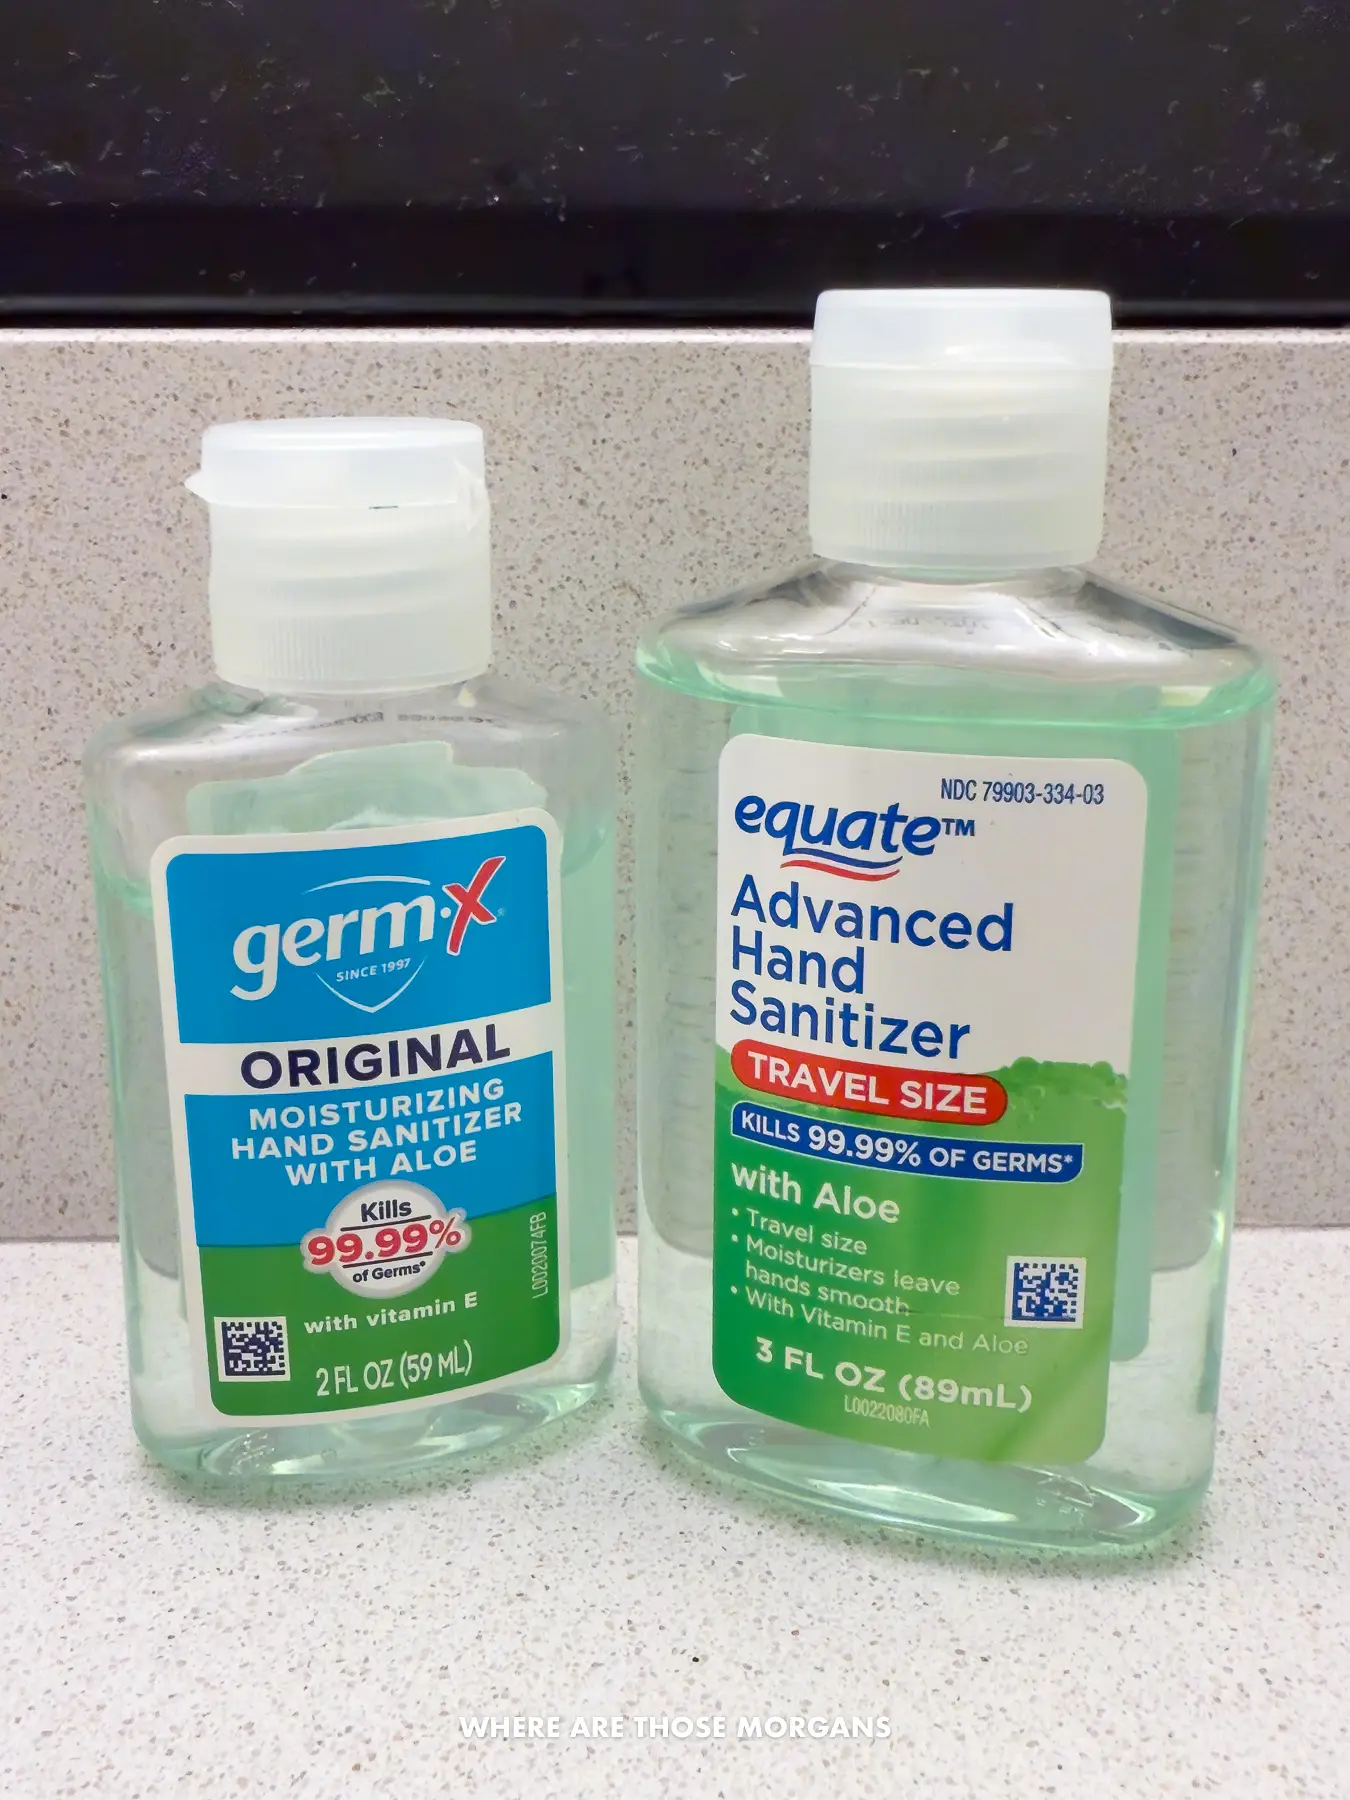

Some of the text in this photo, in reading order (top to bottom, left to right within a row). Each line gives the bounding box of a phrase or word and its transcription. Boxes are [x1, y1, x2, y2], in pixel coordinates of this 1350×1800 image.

[941, 777, 1105, 805] NDC 79903-334-03
[730, 873, 1014, 951] Advanced
[336, 958, 411, 982] SINCE 1997
[732, 925, 865, 995] Hand
[730, 980, 971, 1059] Sanitizer
[240, 1023, 511, 1090] ORIGINAL
[747, 1051, 987, 1115] TRAVEL SIZE
[231, 1102, 522, 1160] HAND SANITIZER
[249, 1078, 504, 1130] MOISTURIZING
[285, 1140, 477, 1186] WITH ALOE
[742, 1110, 801, 1143] KILLS
[808, 1125, 922, 1168] 99.99%
[929, 1146, 966, 1169] OF
[361, 1199, 412, 1223] Kills
[731, 1162, 900, 1224] with Aloe
[308, 1217, 462, 1266] 99.99%
[747, 1207, 868, 1256] Travel size
[352, 1269, 370, 1283] of
[745, 1259, 909, 1318] hands smooth
[746, 1233, 960, 1296] Moisturizers leave
[304, 1291, 478, 1334] with vitamin E
[745, 1285, 1029, 1356] With Vitamin E and Aloe
[316, 1339, 473, 1397] 2 FL OZ (59 ML)
[755, 1336, 1032, 1413] 3 FL OZ (89mL)
